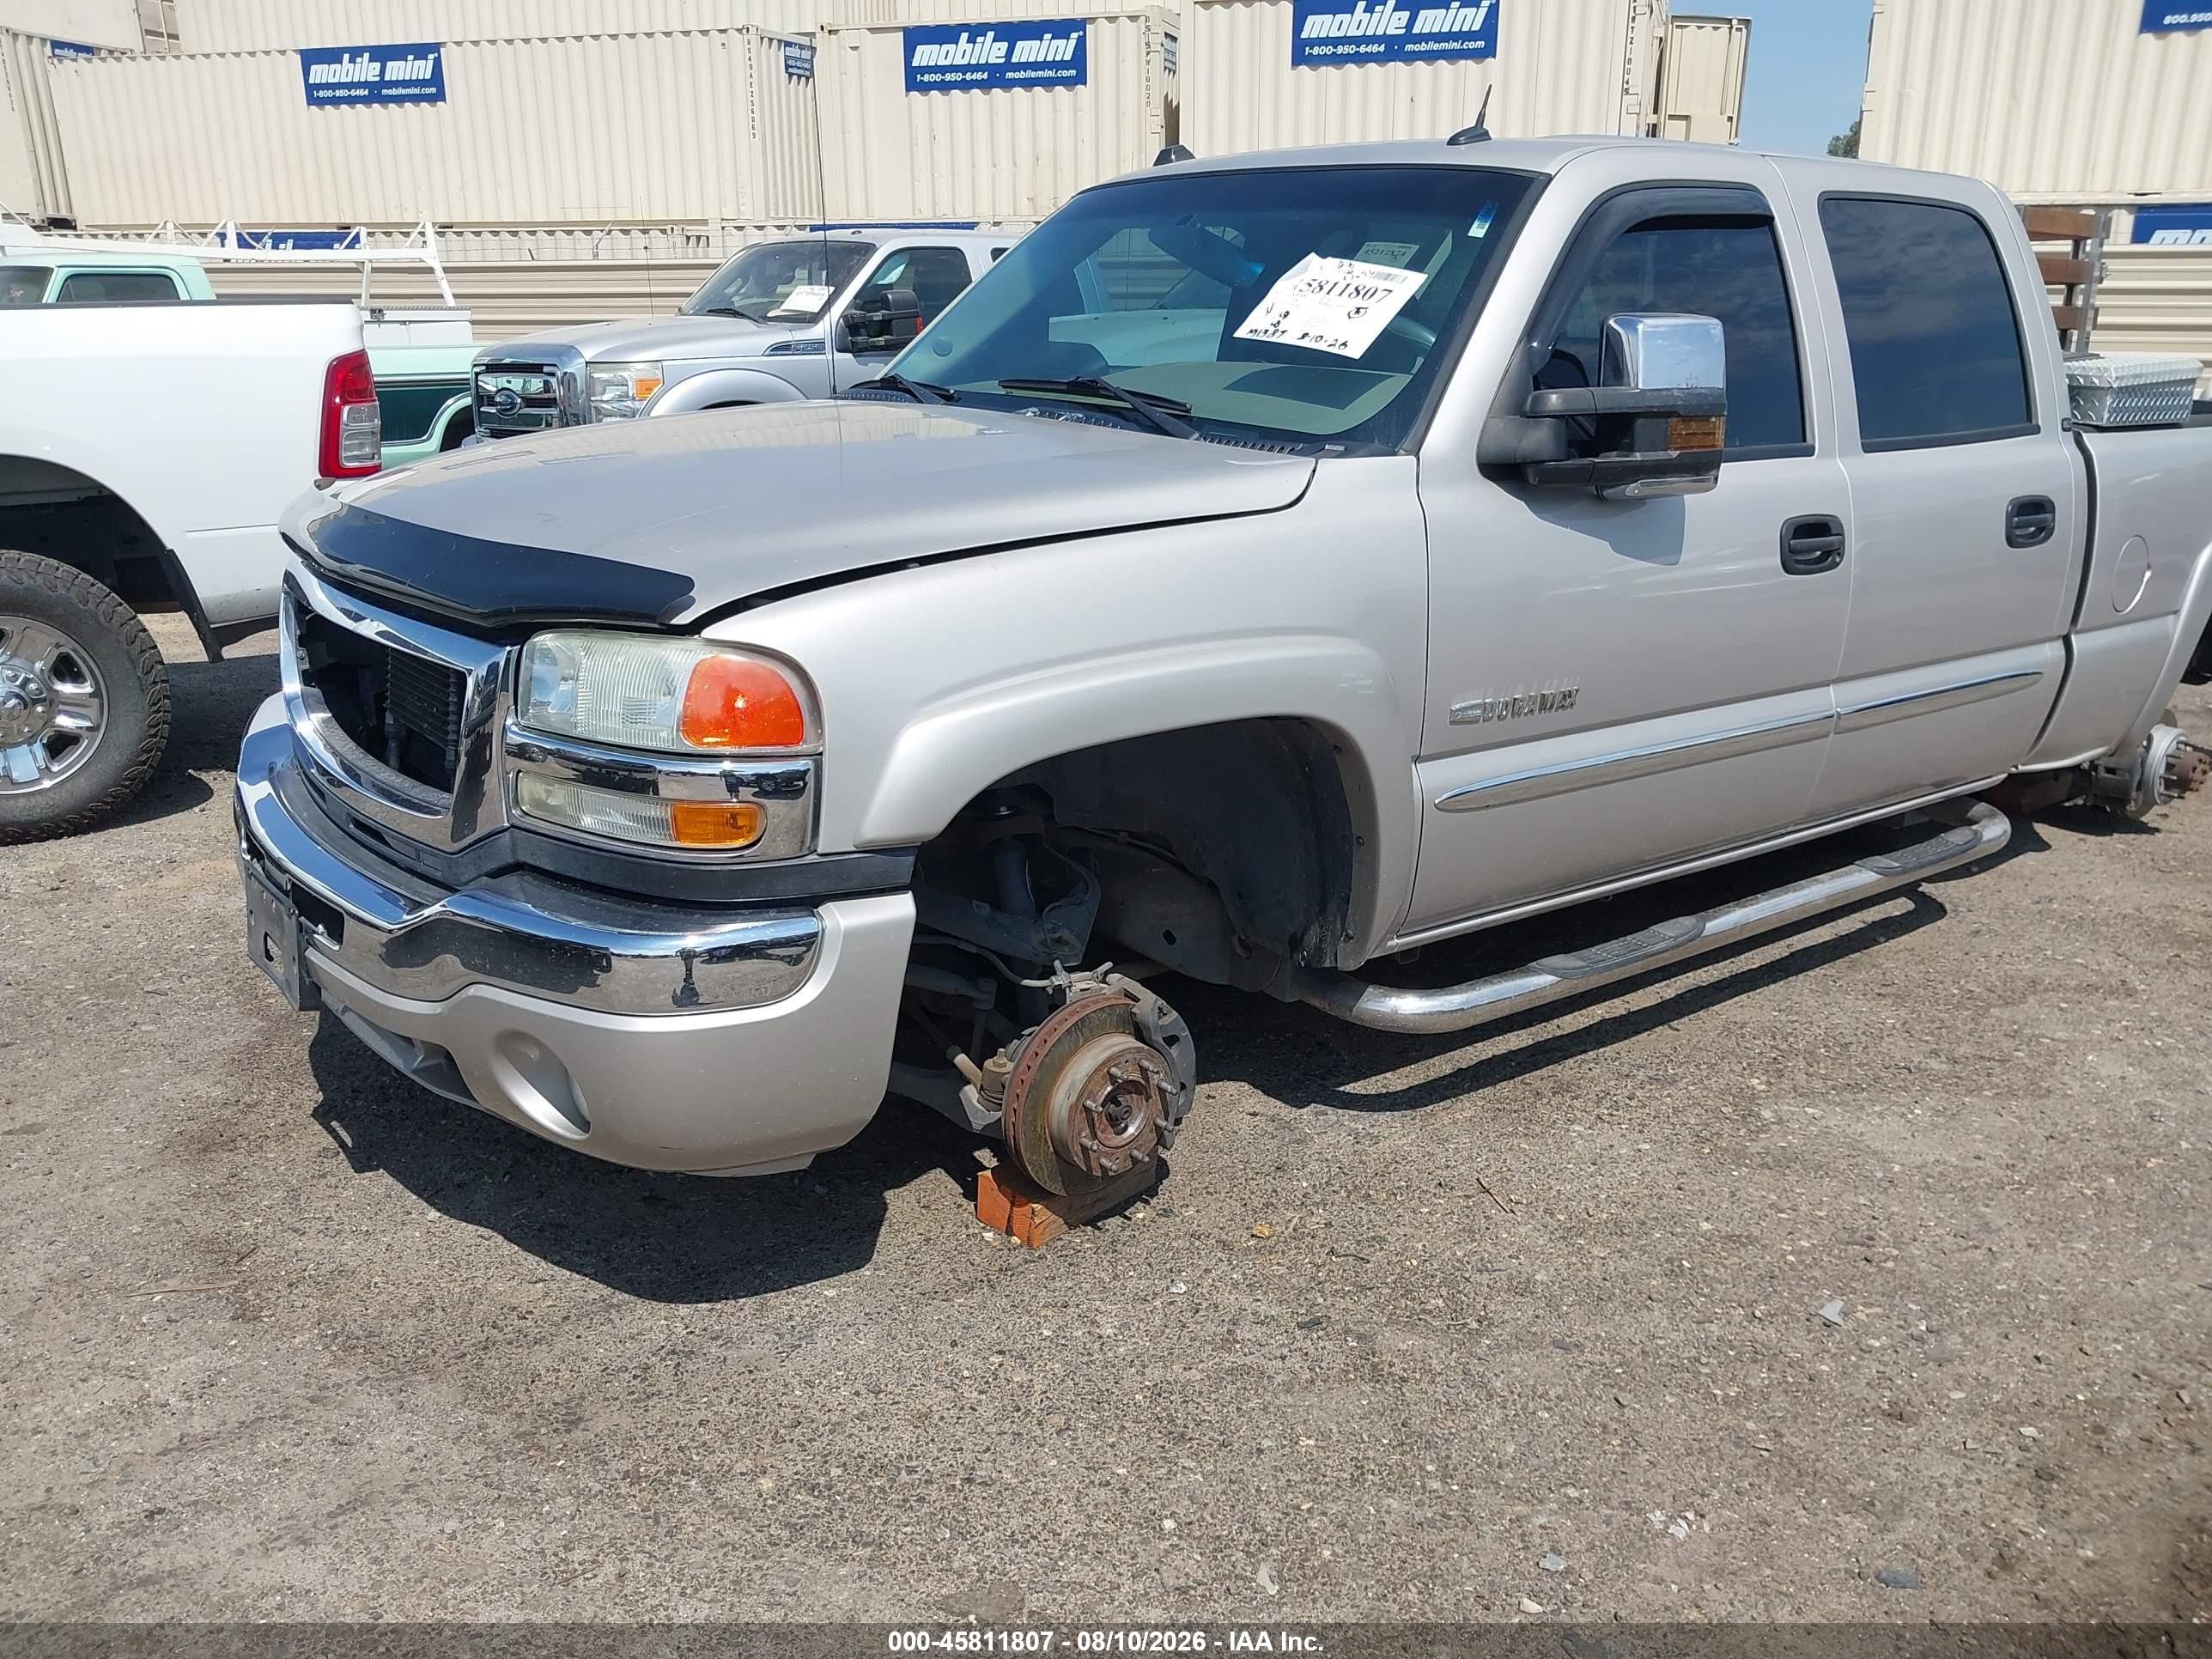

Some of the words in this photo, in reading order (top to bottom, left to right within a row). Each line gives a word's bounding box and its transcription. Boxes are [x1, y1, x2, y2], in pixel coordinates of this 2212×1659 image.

[1300, 0, 1410, 39] mobile
[1412, 1, 1492, 34] mini
[912, 31, 1008, 67] mobile
[1011, 32, 1079, 63] mini
[1304, 44, 1385, 56] 1-800-950-6464
[1404, 40, 1486, 52] mobilemini.com
[308, 52, 380, 84] mobile
[384, 53, 434, 82] mini
[916, 71, 988, 82] 1-800-950-6464
[1006, 69, 1077, 80] mobilemini.com
[313, 88, 369, 98] 1-800-950-6464
[381, 87, 436, 96] mobilemini.com
[1482, 686, 1580, 723] DURAMAX
